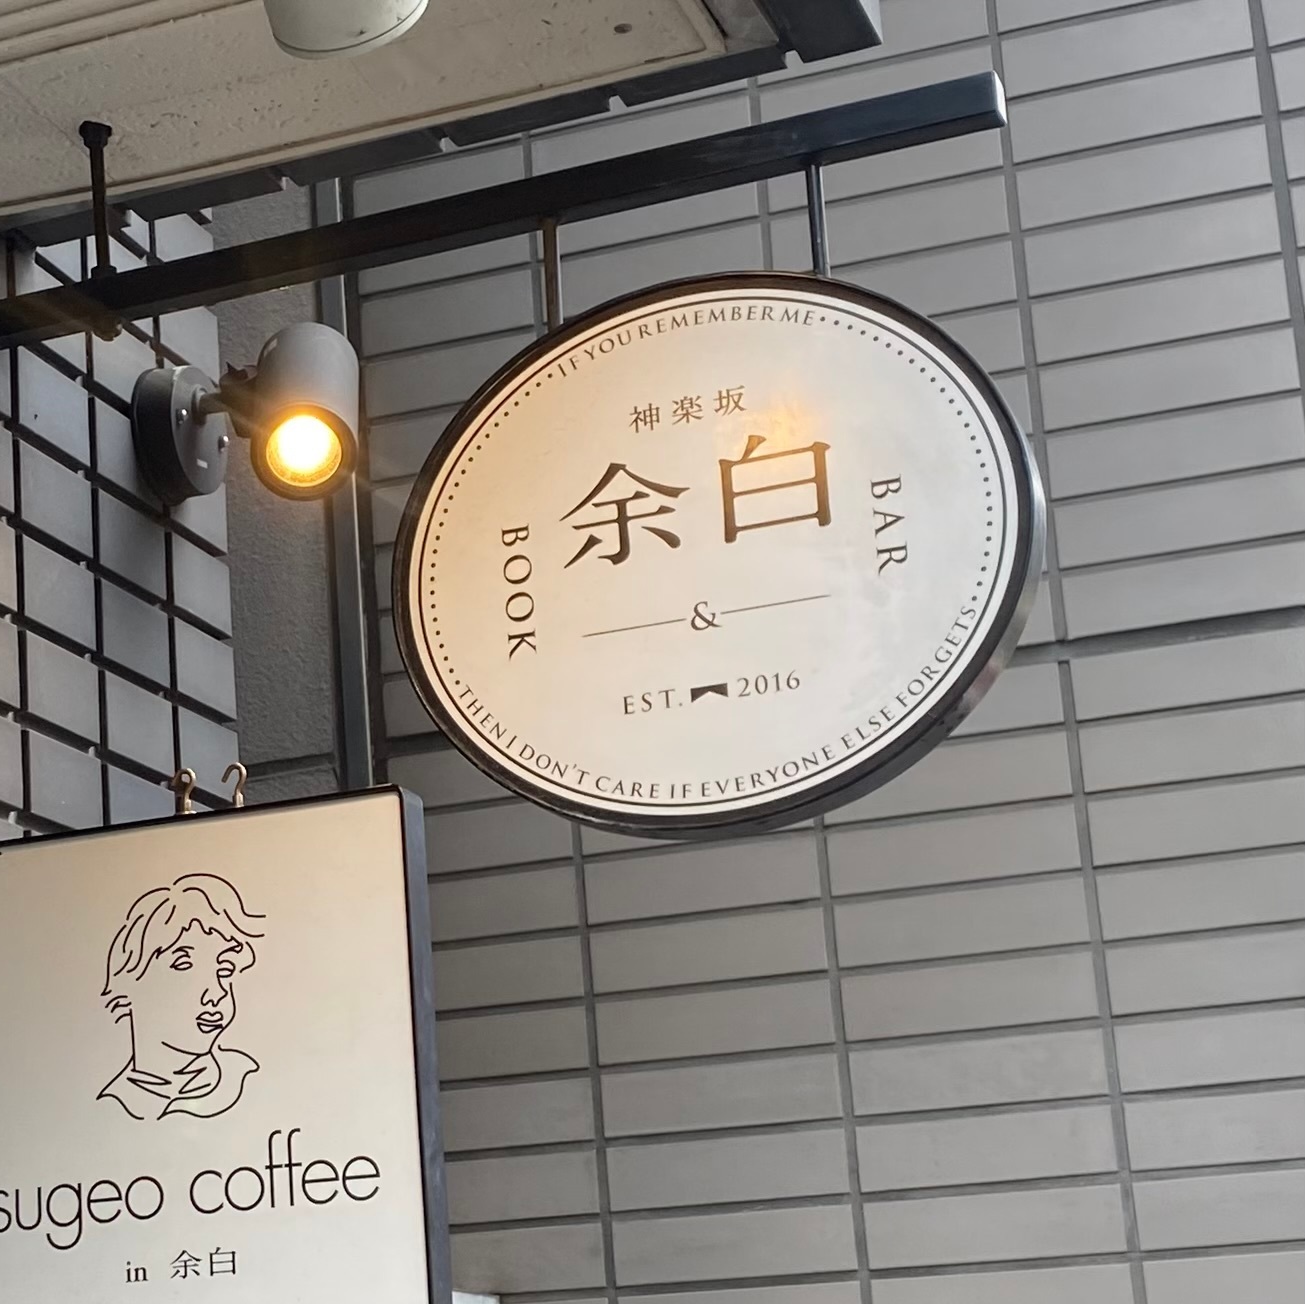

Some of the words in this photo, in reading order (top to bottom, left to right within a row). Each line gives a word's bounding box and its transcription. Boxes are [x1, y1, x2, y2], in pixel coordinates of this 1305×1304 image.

[557, 357, 580, 378] IF
[583, 330, 634, 361] YOU
[638, 305, 776, 340] REMEMBER
[778, 306, 816, 326] ME
[628, 385, 747, 434] 神楽坂
[559, 433, 832, 570] 余白
[869, 473, 909, 576] BAR
[500, 523, 538, 662] BOOK
[689, 600, 723, 632] &
[456, 684, 508, 749] THEN
[517, 744, 592, 788] DON'T
[595, 773, 661, 801] CARE
[668, 783, 694, 800] IF
[700, 744, 838, 799] EVERYONE
[839, 706, 897, 753] ELSE
[894, 603, 978, 710] FORGETS
[622, 690, 685, 716] EST.
[736, 669, 801, 698] 2016
[189, 1128, 381, 1214] coffee
[126, 1260, 148, 1284] in
[169, 1246, 238, 1280] 余白
